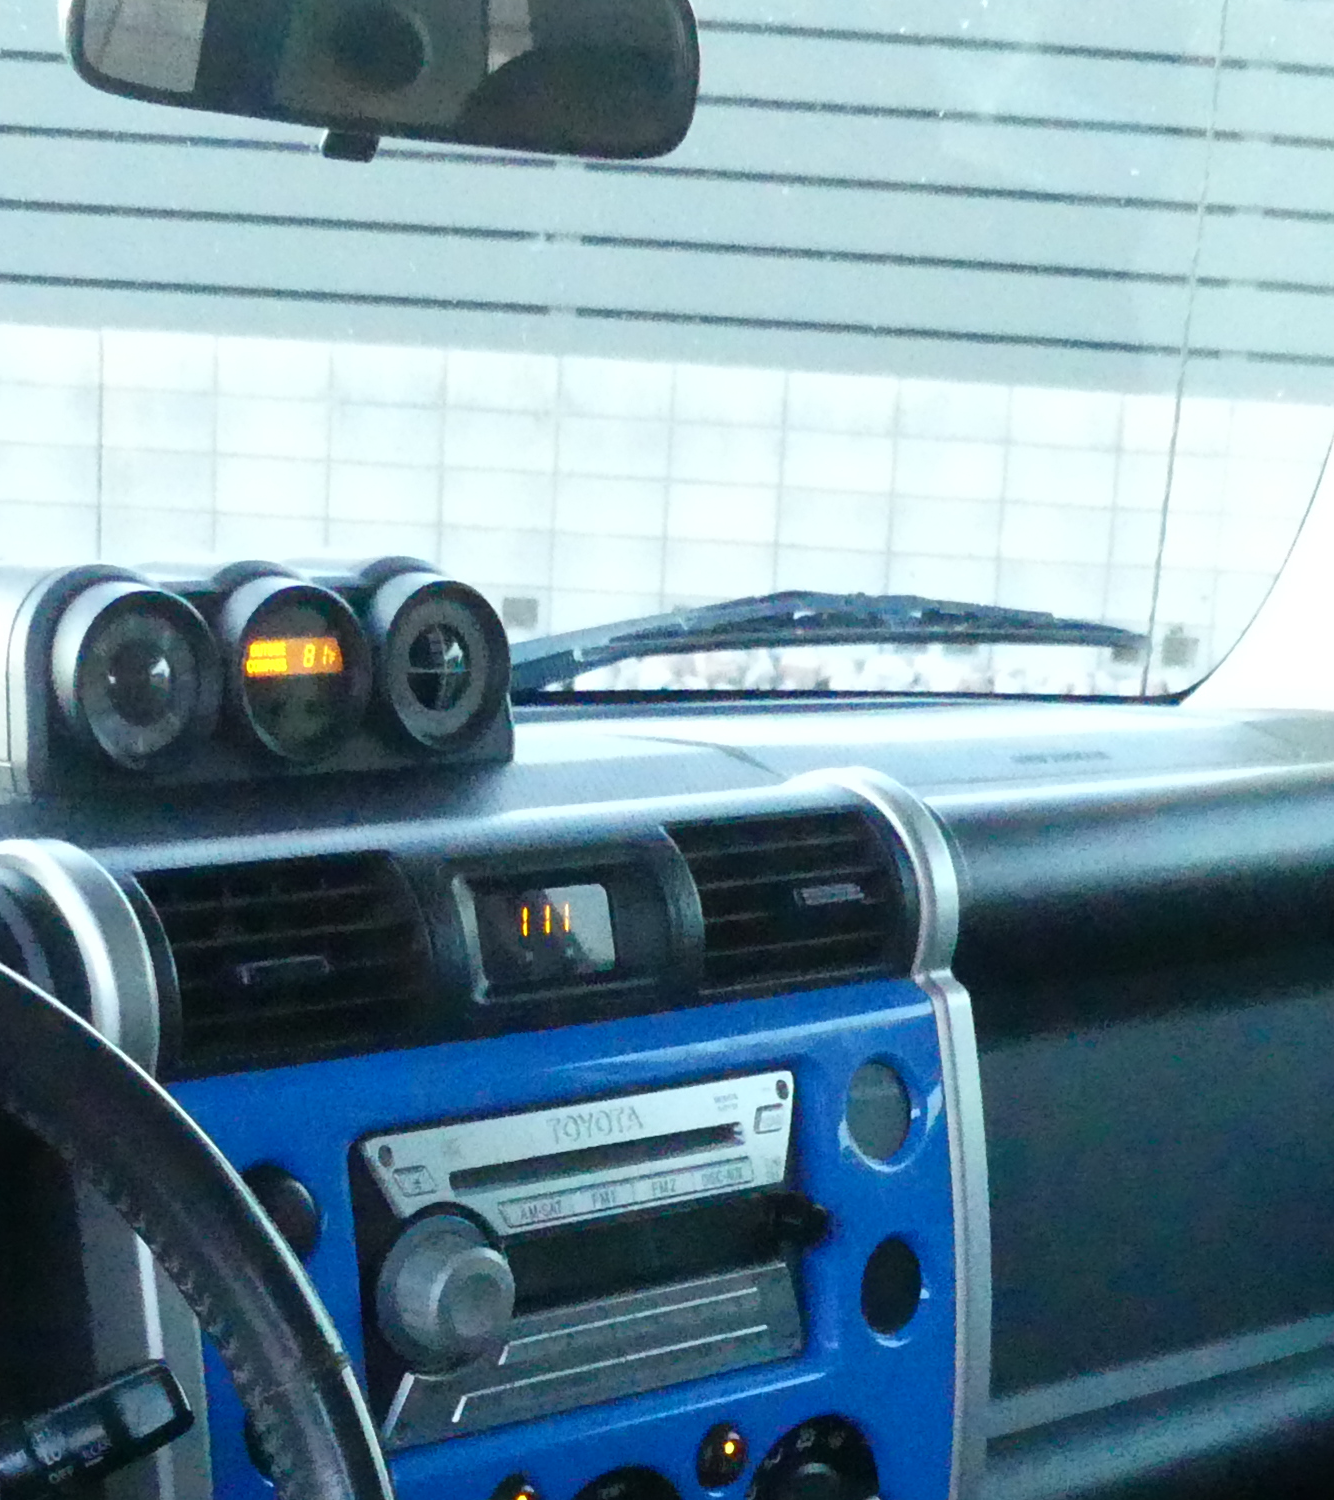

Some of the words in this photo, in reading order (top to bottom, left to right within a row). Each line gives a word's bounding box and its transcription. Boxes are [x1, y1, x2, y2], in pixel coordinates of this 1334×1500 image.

[546, 1105, 643, 1144] TOYOTA
[651, 1178, 677, 1196] FM2
[592, 1189, 618, 1209] FM1
